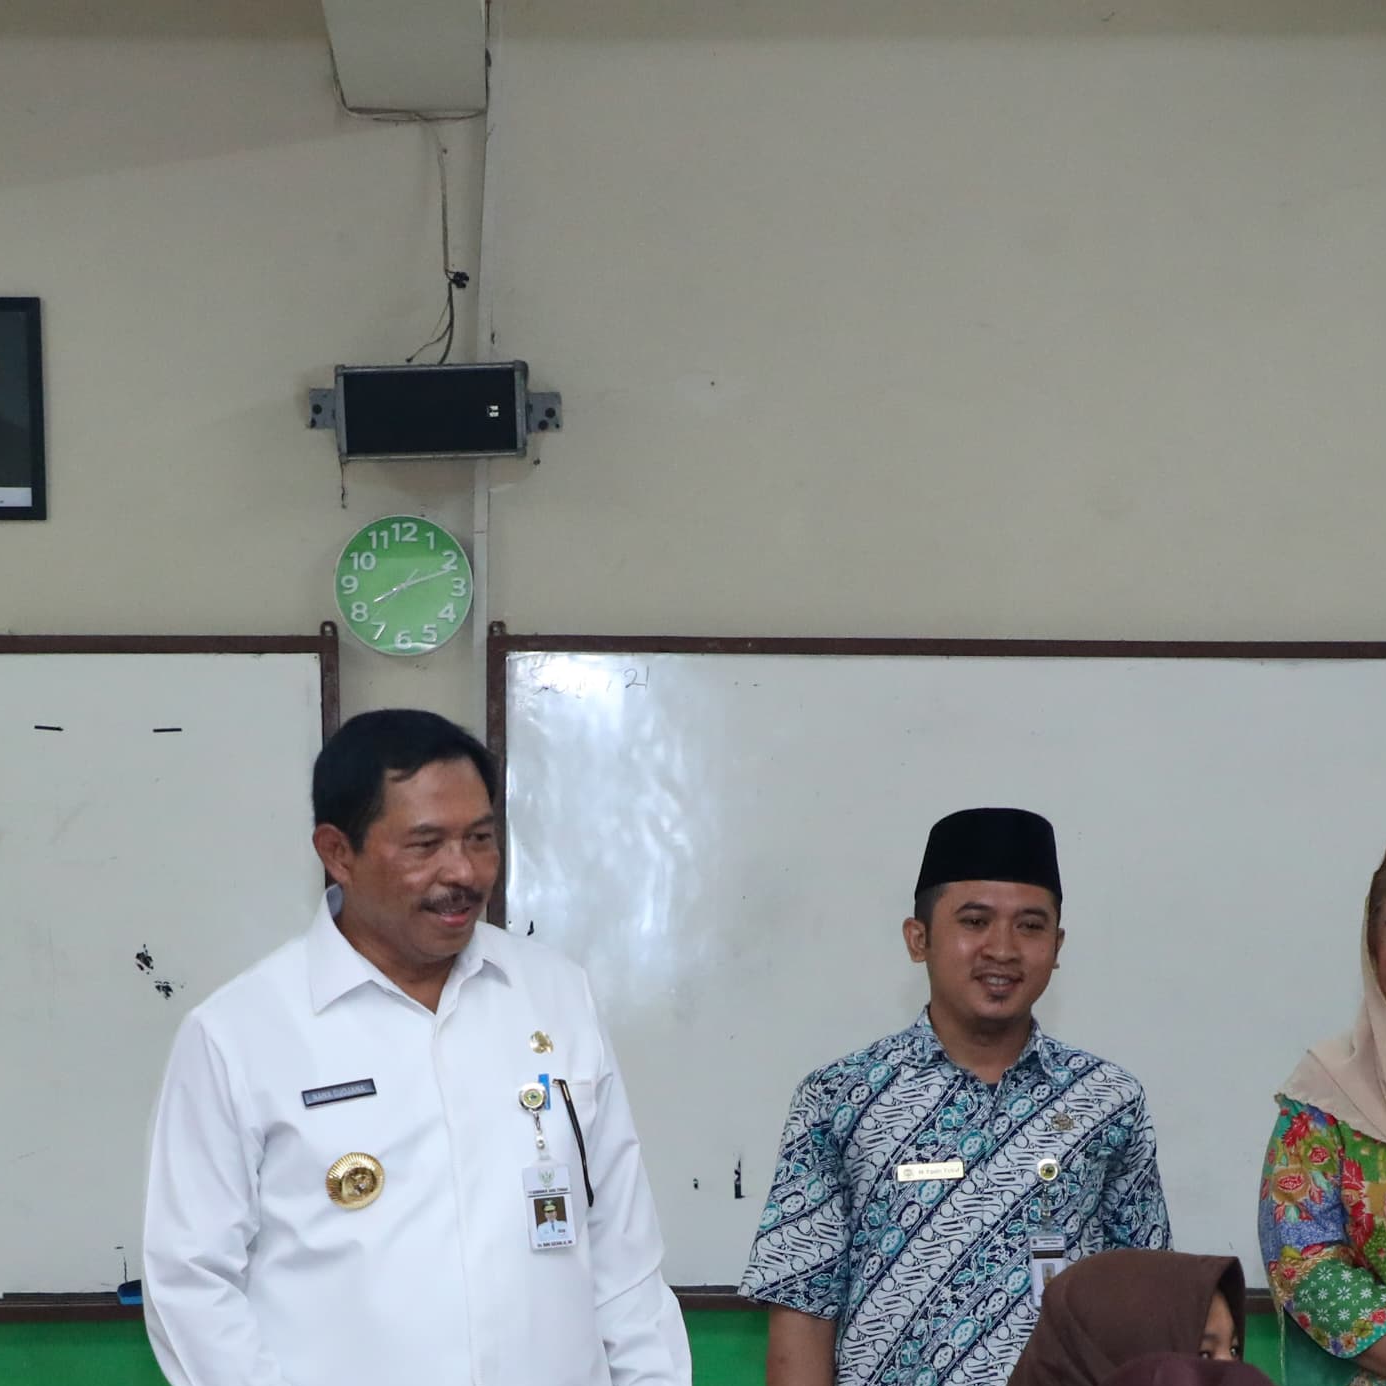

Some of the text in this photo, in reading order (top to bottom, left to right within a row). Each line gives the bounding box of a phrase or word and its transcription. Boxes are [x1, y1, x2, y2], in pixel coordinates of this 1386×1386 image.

[368, 530, 389, 550] 11
[392, 522, 418, 542] 12
[426, 532, 435, 550] 1
[350, 552, 376, 570] 10
[442, 550, 458, 570] 2
[341, 575, 358, 594] 9
[451, 578, 466, 597] 3
[352, 602, 368, 622] 8
[438, 603, 456, 622] 4
[372, 622, 386, 640] 7
[395, 631, 412, 650] 6
[422, 624, 437, 642] 5
